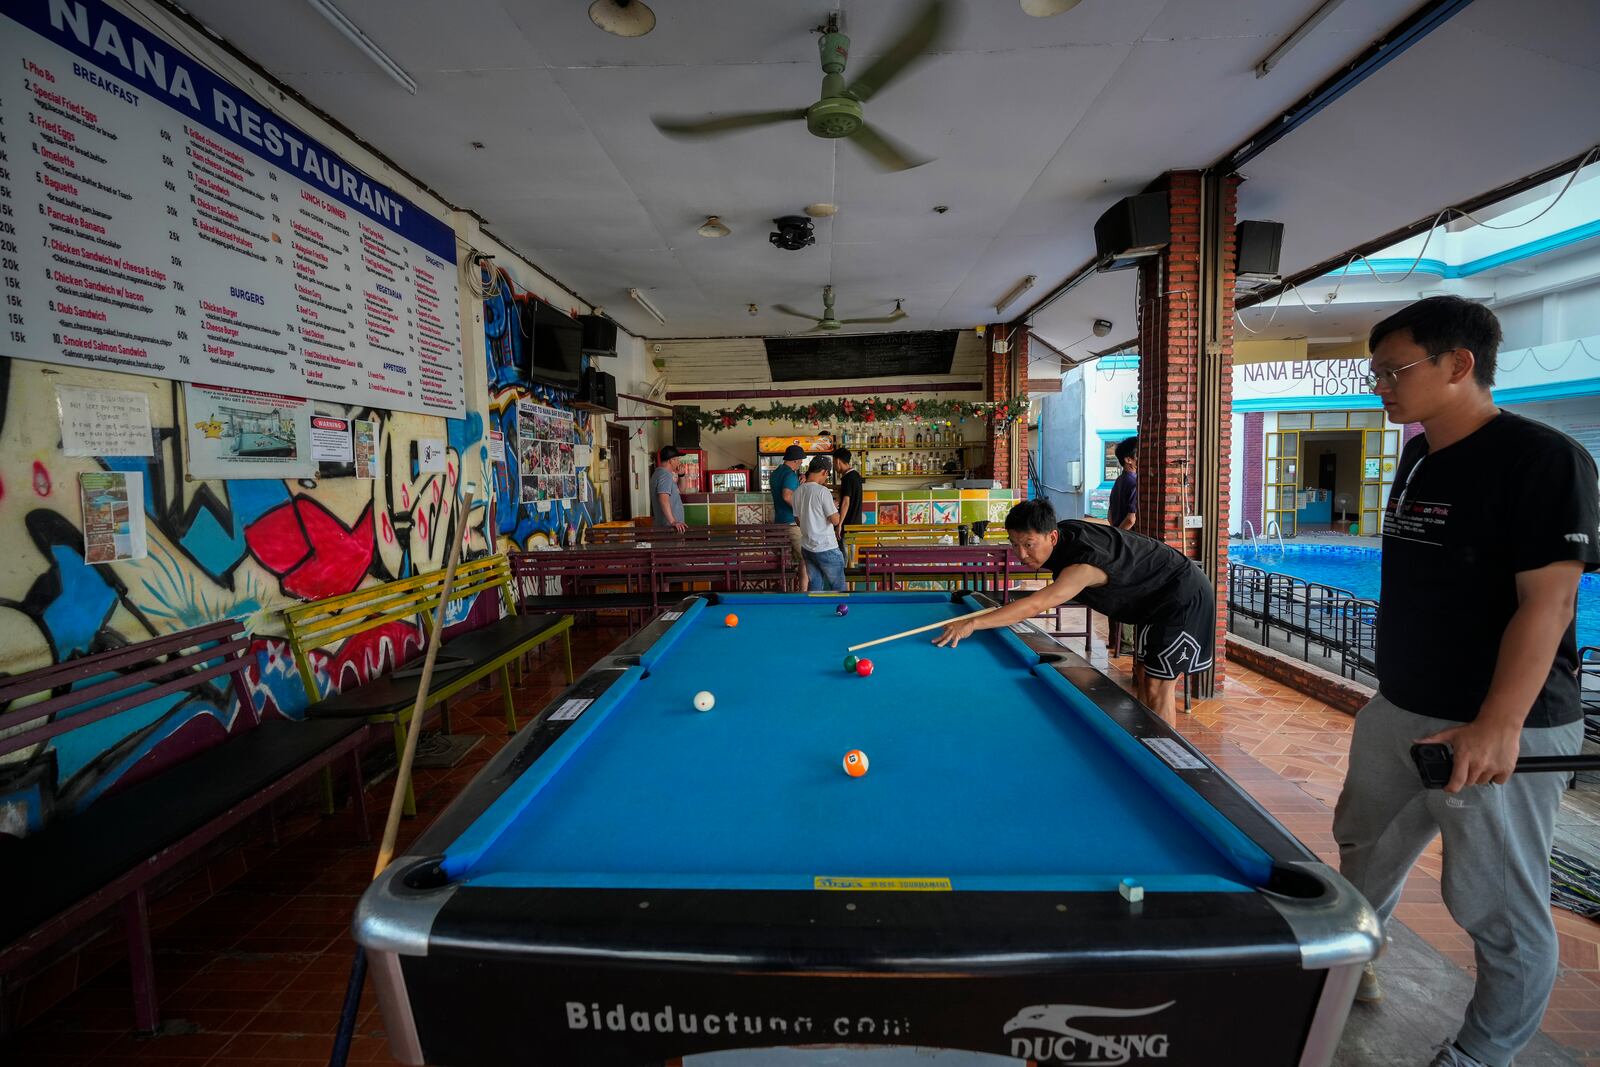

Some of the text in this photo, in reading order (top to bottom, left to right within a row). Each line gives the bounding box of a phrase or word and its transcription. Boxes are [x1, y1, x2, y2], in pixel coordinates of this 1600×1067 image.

[28, 60, 43, 78] Pho
[44, 68, 55, 84] Bo
[72, 61, 139, 108] BREAKFAST
[32, 82, 62, 108] Special
[62, 97, 79, 114] Fried
[80, 105, 97, 125] Eggs
[48, 0, 404, 227] NANA RESTAURANT
[37, 115, 56, 133] Fried
[57, 124, 75, 144] Eggs
[40, 145, 74, 169] Omelette
[205, 136, 222, 153] cheese
[222, 145, 244, 165] sandwich
[204, 156, 222, 172] cheese
[222, 164, 243, 183] sandwich
[207, 179, 230, 197] Sandwich
[43, 173, 78, 198] Baguette
[168, 229, 180, 242] 25k
[196, 196, 217, 213] Chicken
[216, 205, 239, 222] Sandwich
[300, 188, 320, 207] LUNCH
[326, 202, 347, 221] DINNER
[47, 205, 79, 226] Pancake
[79, 216, 106, 235] Banana
[0, 239, 17, 253] 20k
[3, 257, 19, 271] 20k
[50, 238, 80, 256] Chicken
[81, 247, 112, 265] Sandwich
[122, 259, 144, 274] cheese
[150, 268, 166, 282] chips
[172, 279, 184, 292] 70k
[5, 276, 20, 289] 15k
[53, 269, 83, 287] Chicken
[83, 277, 115, 295] Sandwich
[124, 287, 144, 302] bacon
[175, 304, 186, 316] 70k
[375, 282, 402, 301] VEGETARIAN
[6, 294, 22, 307] 15k
[229, 286, 265, 305] BURGERS
[8, 312, 24, 325] 15k
[56, 301, 73, 315] Club
[73, 305, 106, 322] Sandwich
[203, 301, 223, 314] Chicken
[222, 306, 238, 319] Burger
[10, 330, 25, 342] 15k
[205, 321, 224, 333] Cheese
[223, 325, 239, 338] Burger
[63, 334, 92, 349] Smoked
[92, 339, 117, 353] Salmon
[118, 343, 147, 358] Sandwich
[178, 354, 190, 365] 70k
[219, 346, 235, 359] Burger
[383, 361, 406, 374] APPETIZERS
[1244, 361, 1287, 382] NANA
[521, 402, 538, 412] WELCOME
[318, 419, 342, 429] WARNING
[1432, 506, 1449, 516] Pink
[1011, 1036, 1077, 1061] DUC
